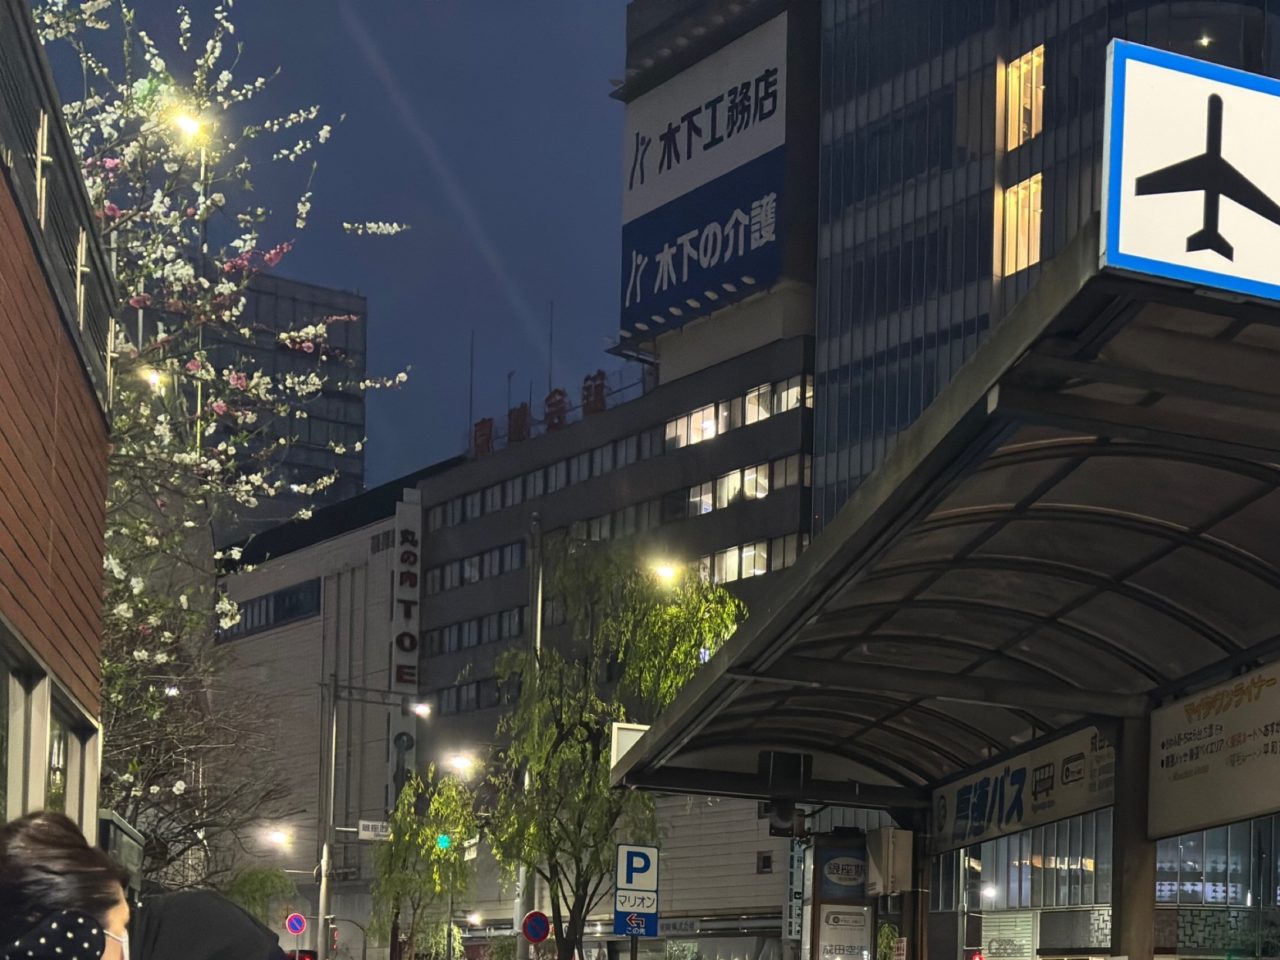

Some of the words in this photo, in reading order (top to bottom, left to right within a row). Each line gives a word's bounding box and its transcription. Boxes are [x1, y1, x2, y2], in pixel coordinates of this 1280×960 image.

[658, 67, 778, 174] 木下工務店
[654, 192, 777, 294] 木下の介護
[626, 851, 651, 884] P
[618, 895, 656, 909] マリオン
